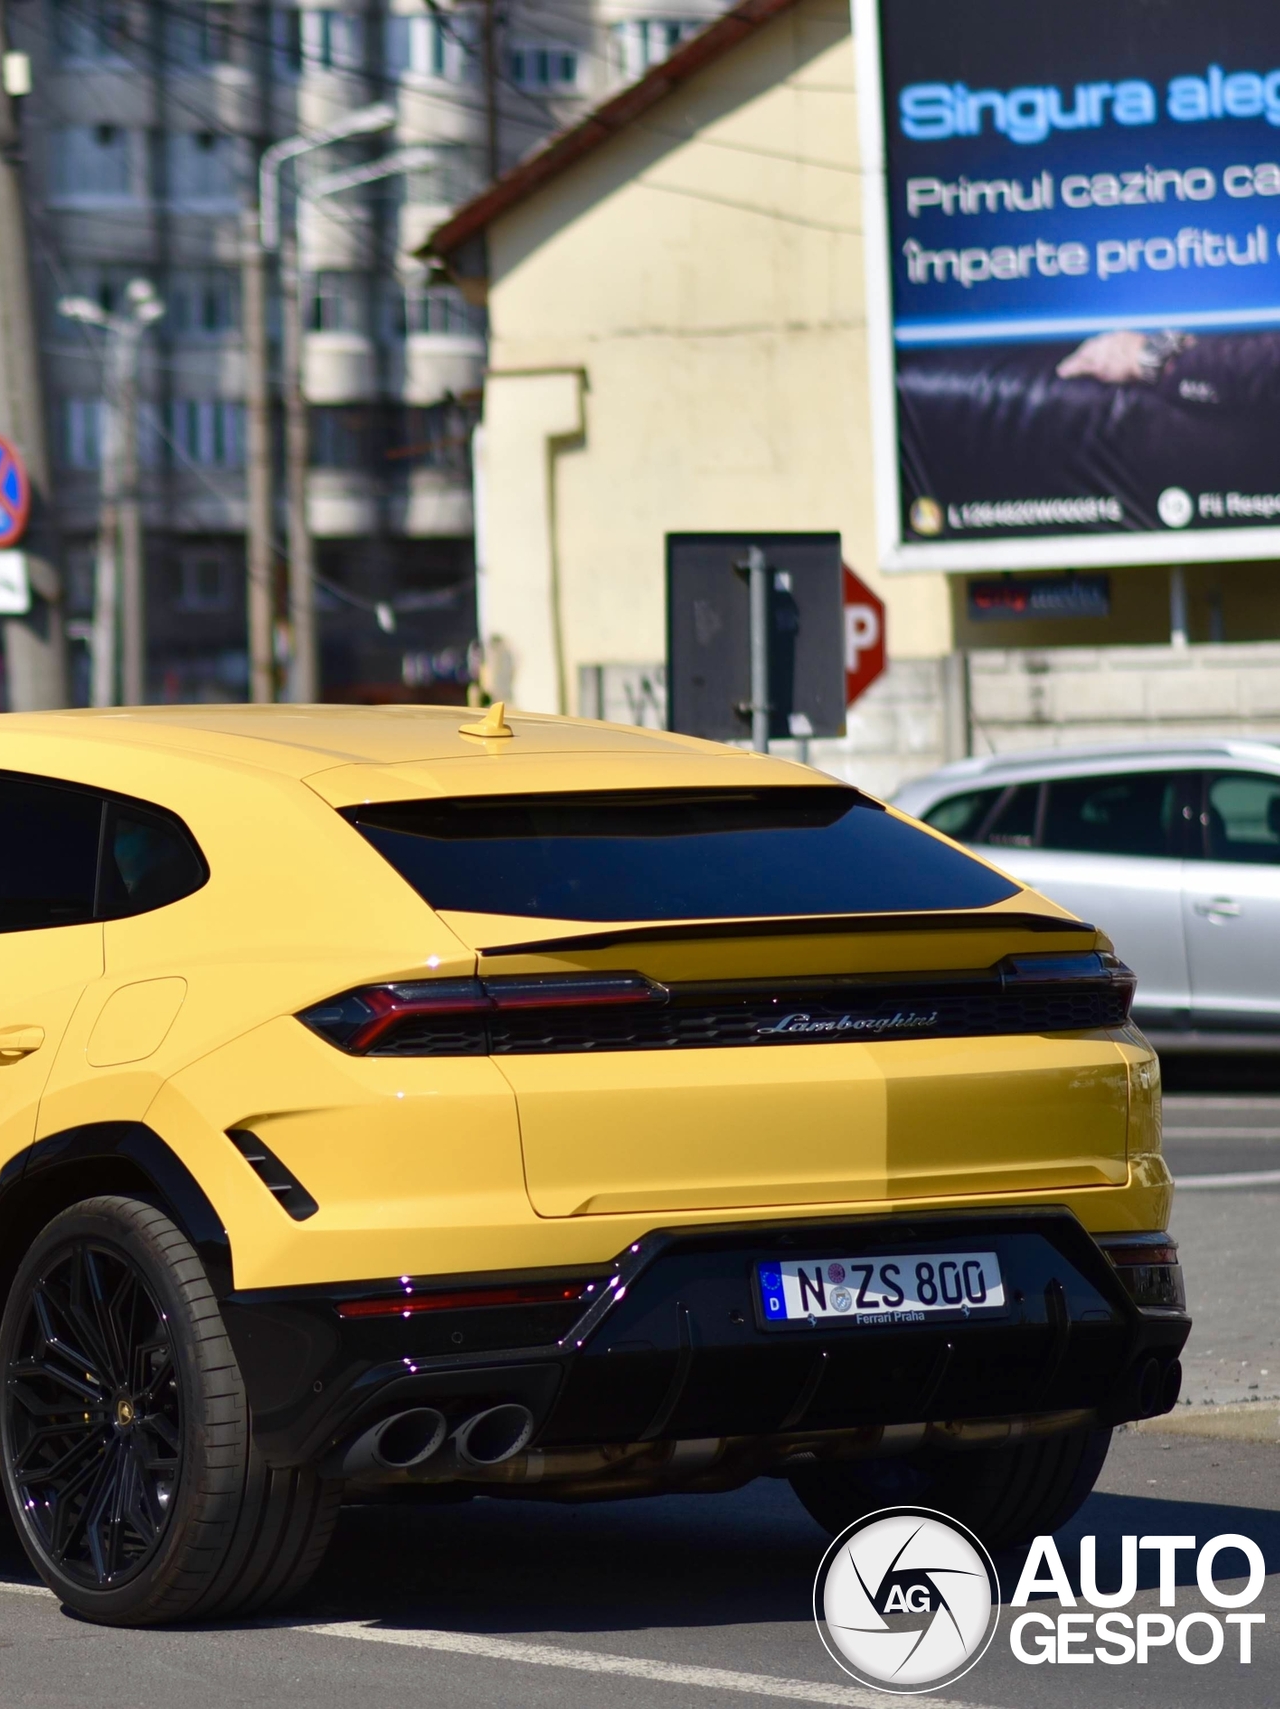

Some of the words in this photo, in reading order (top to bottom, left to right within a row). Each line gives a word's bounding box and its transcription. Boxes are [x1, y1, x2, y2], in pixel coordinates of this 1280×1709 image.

[900, 81, 1156, 145] Singura
[907, 169, 1053, 218] Primul
[1061, 164, 1216, 208] cazino
[1096, 224, 1269, 281] profitul
[757, 1011, 938, 1035] Lamborghini
[769, 1296, 781, 1312] D
[797, 1266, 828, 1312] N
[851, 1263, 905, 1309] ZS
[915, 1260, 987, 1306] 800
[856, 1312, 892, 1325] Ferrari
[894, 1310, 926, 1323] Praha
